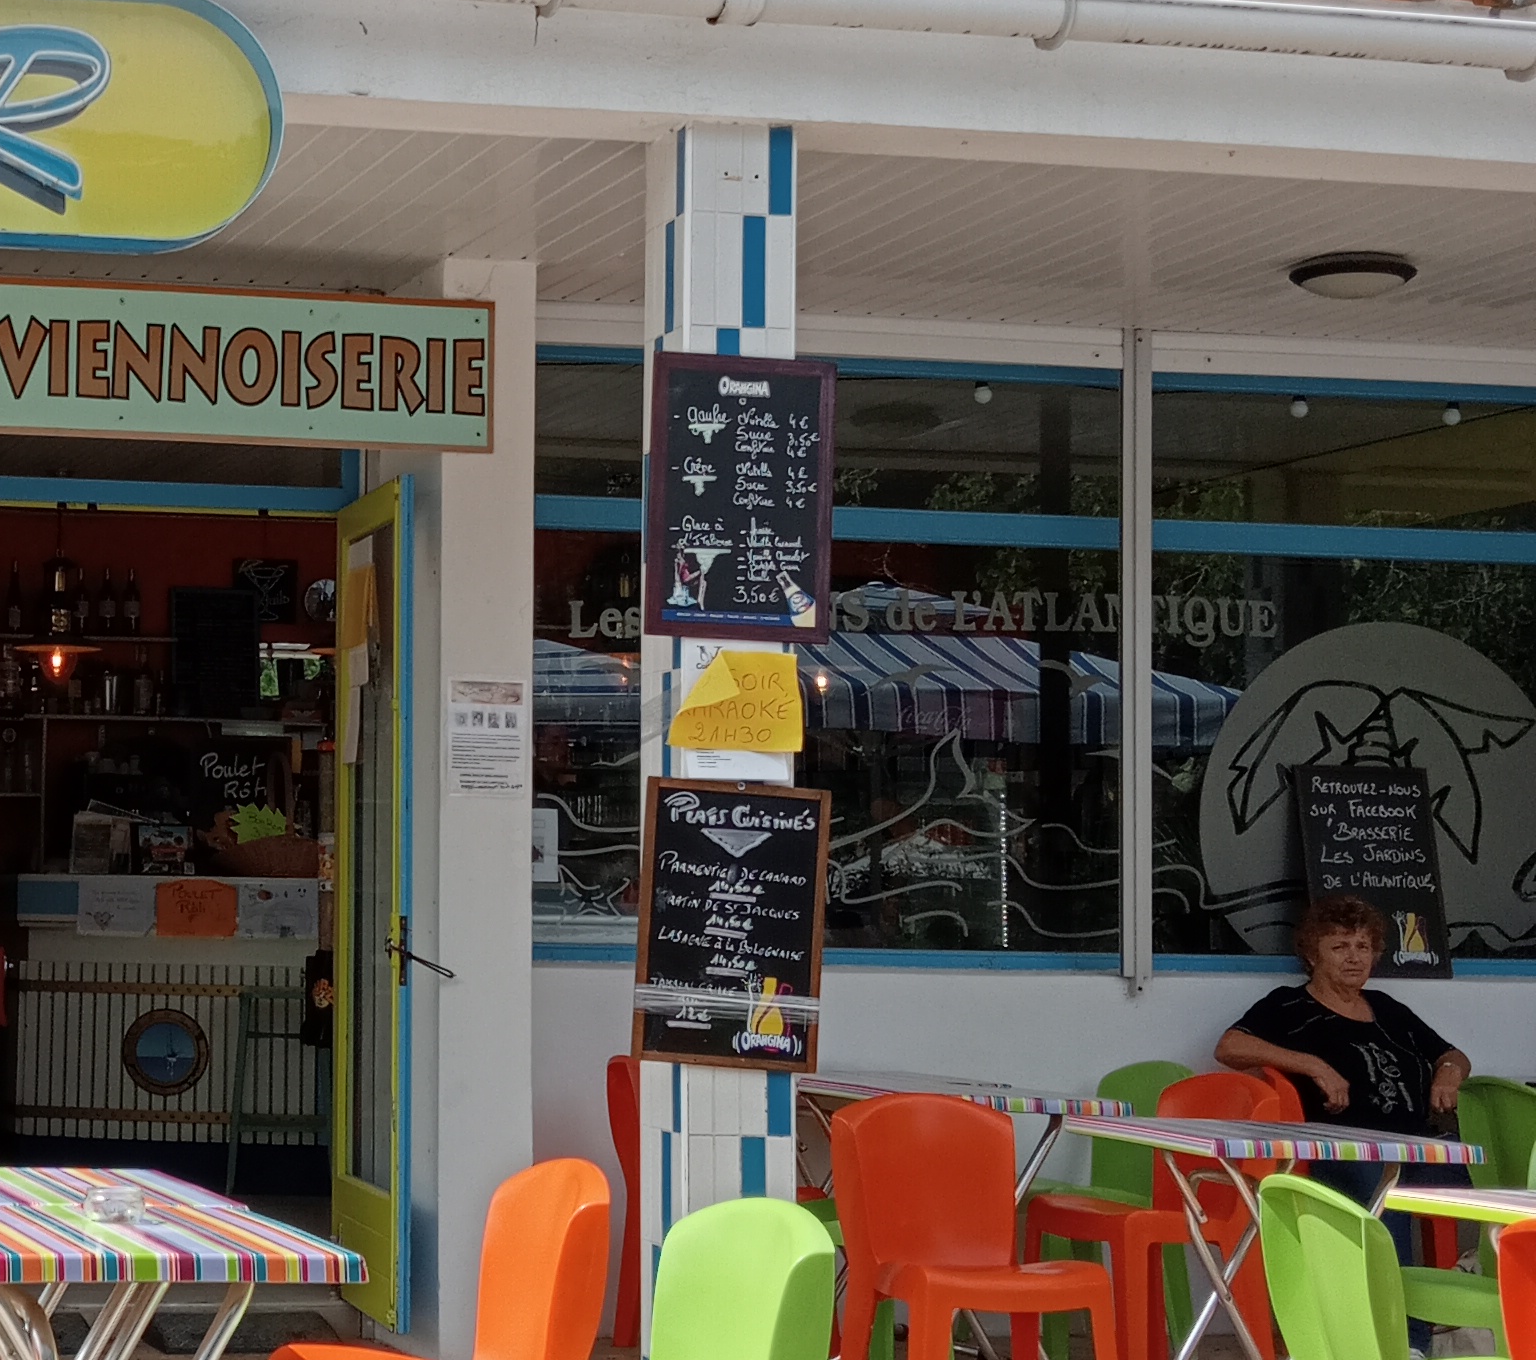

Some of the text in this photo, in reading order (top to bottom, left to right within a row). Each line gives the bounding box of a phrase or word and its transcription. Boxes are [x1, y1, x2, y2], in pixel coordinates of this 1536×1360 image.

[200, 752, 266, 779] Poulet
[1348, 798, 1417, 820] FACEBOOK
[658, 850, 737, 876] PARMENTIE
[1320, 843, 1426, 864] LES JARDINS
[1322, 873, 1343, 889] DE
